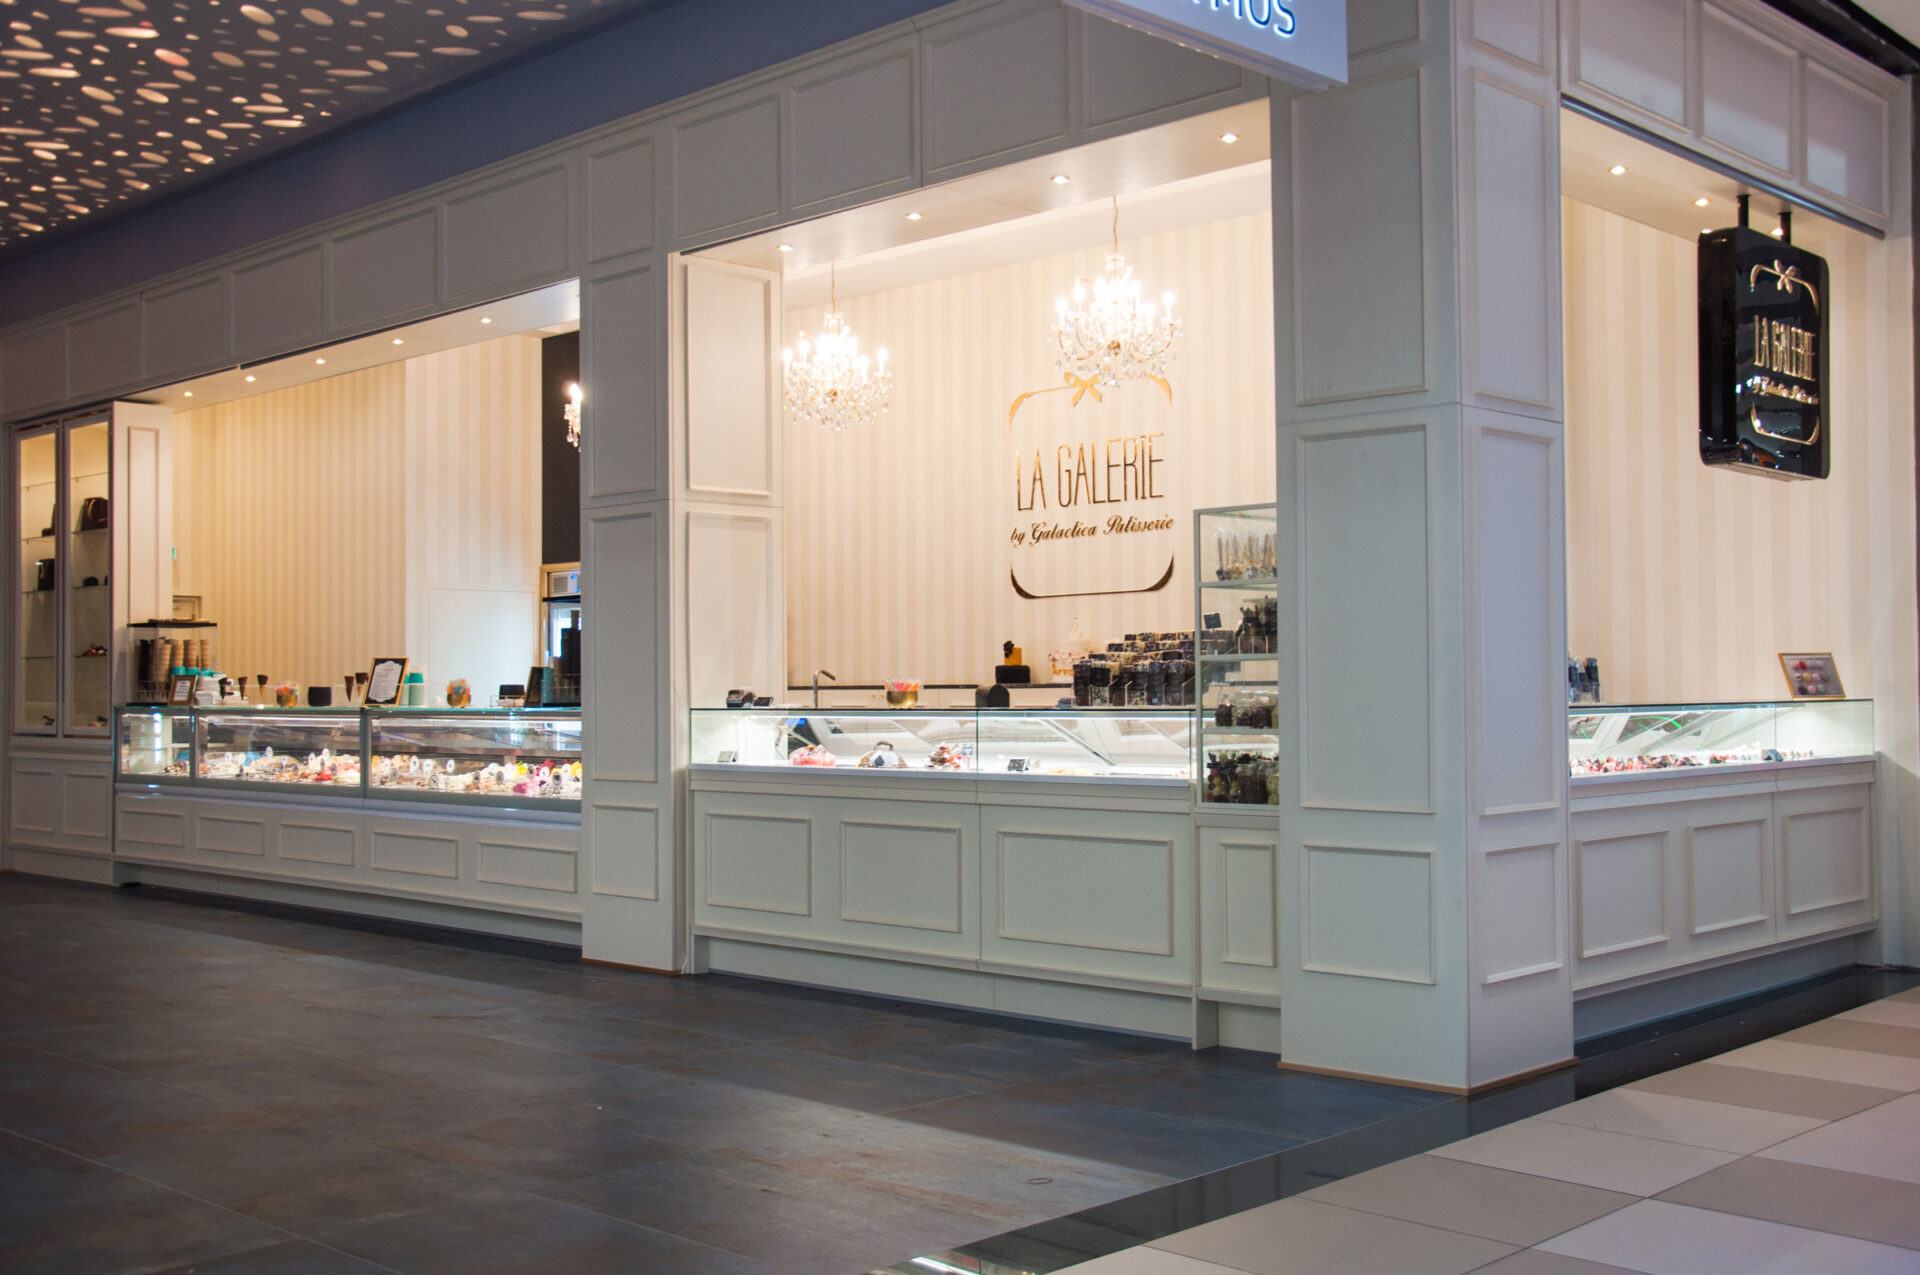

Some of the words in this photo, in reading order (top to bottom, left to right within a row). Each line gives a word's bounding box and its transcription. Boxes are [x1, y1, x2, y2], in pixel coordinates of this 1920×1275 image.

[1754, 314, 1770, 368] LA
[1016, 449, 1046, 511] LA
[1057, 432, 1164, 508] GALERIE
[1010, 527, 1025, 547] by
[1029, 521, 1097, 547] Galactica
[1102, 514, 1174, 535] Patisserie
